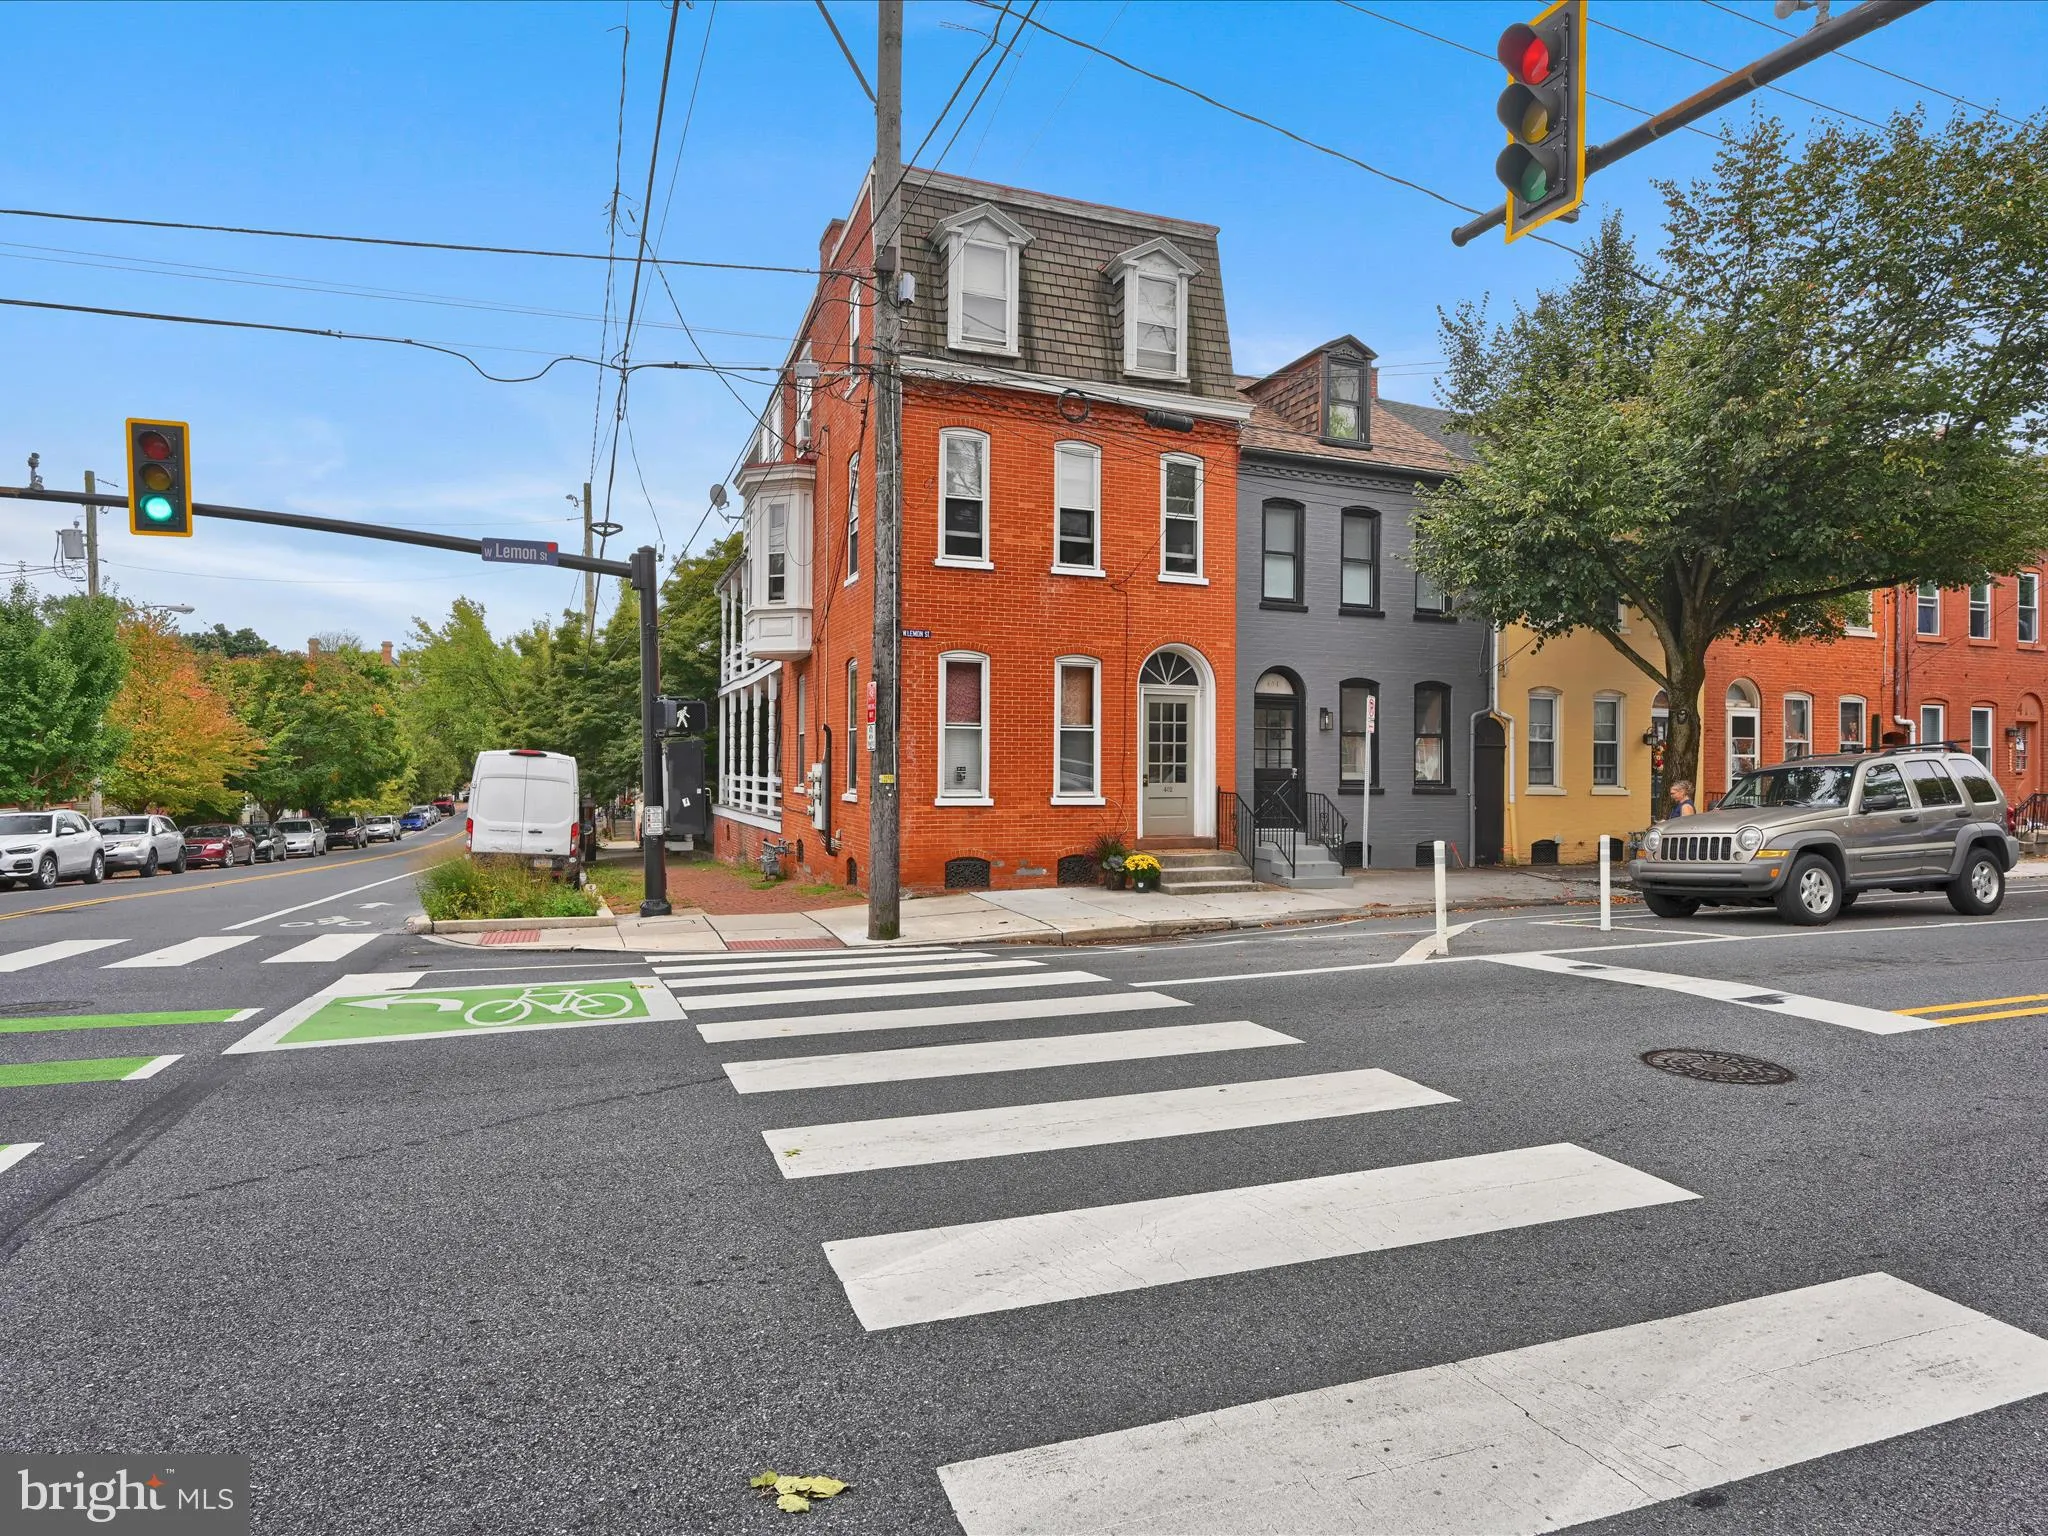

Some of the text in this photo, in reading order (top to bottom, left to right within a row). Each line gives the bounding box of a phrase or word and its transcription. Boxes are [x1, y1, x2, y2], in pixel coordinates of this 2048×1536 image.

[495, 543, 537, 560] Lemon
[539, 551, 548, 561] St
[907, 630, 924, 638] LEMON
